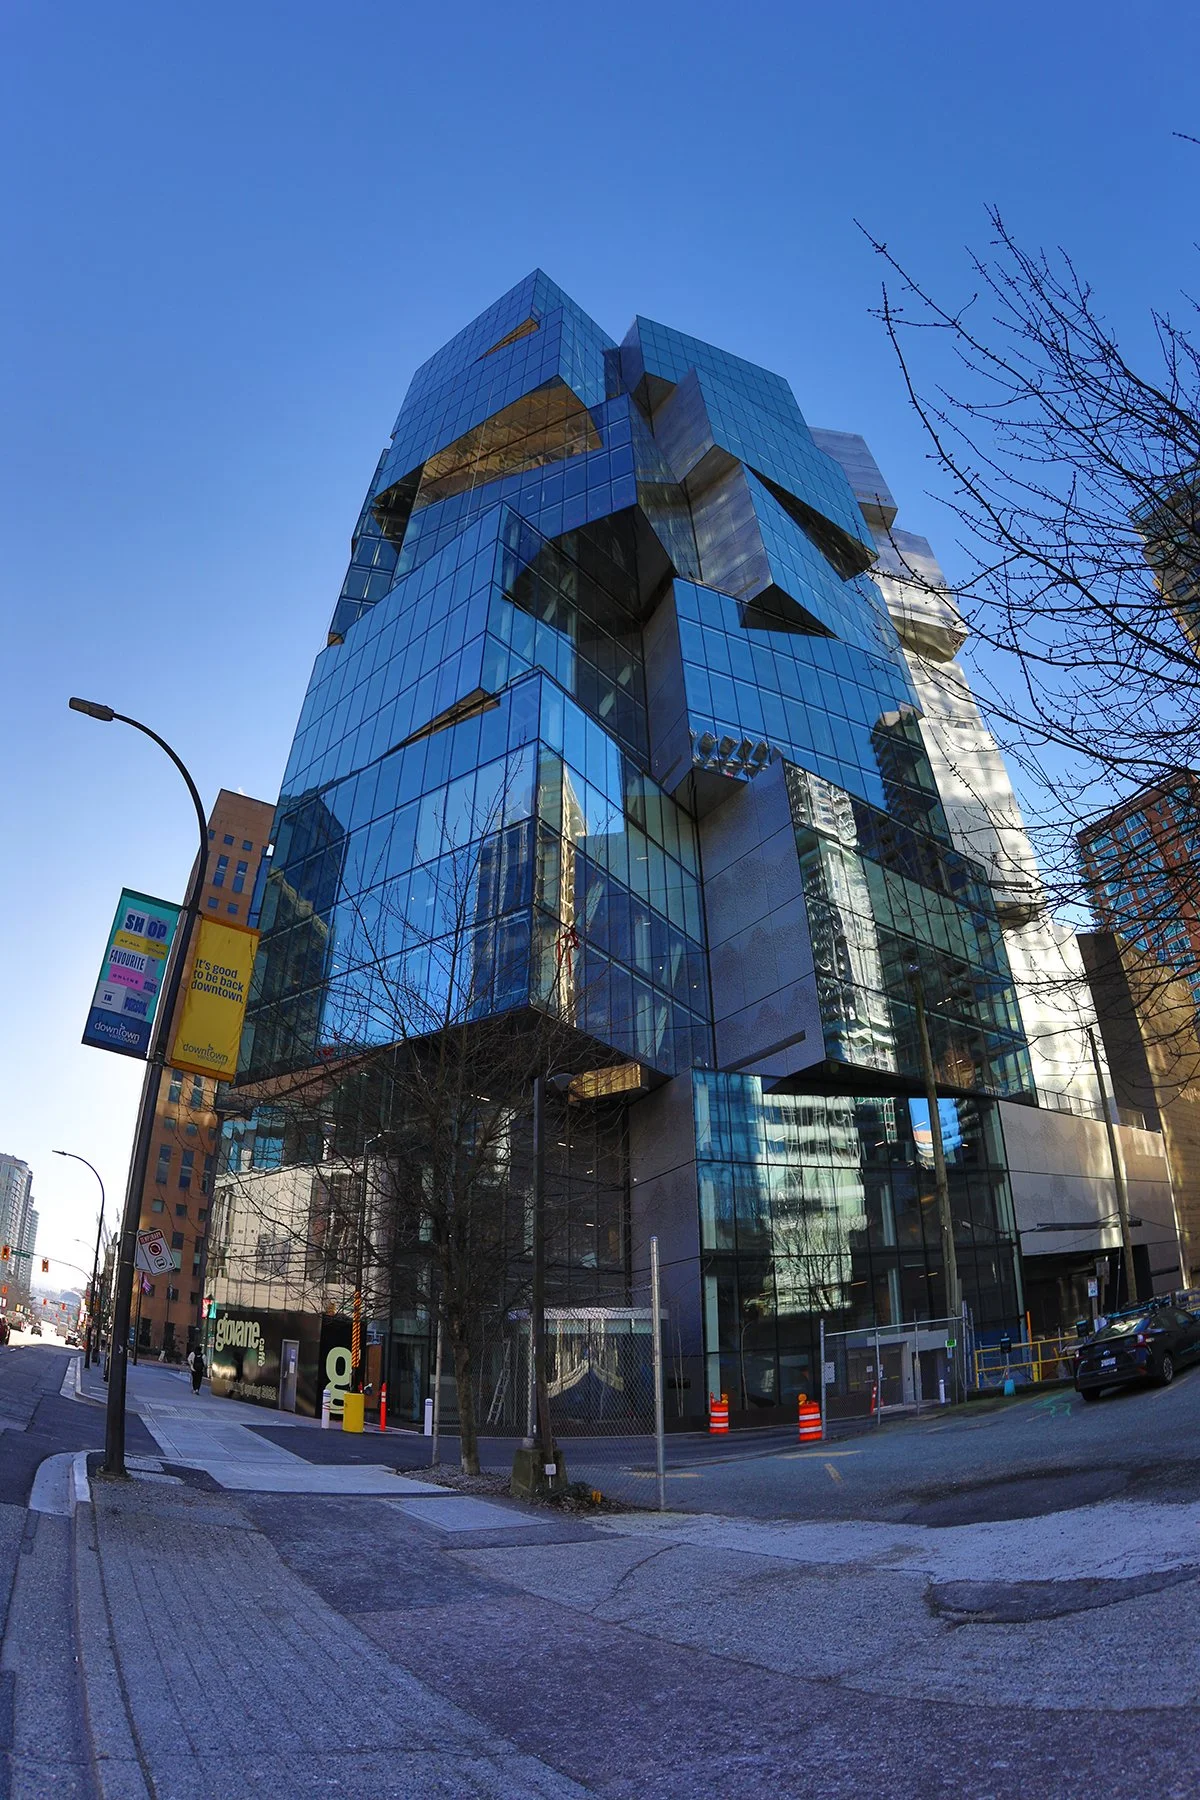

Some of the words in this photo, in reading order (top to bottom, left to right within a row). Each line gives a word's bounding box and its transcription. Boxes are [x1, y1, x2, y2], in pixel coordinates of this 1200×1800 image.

[125, 913, 168, 939] SHOP
[109, 949, 146, 972] FAVOURITE
[195, 958, 211, 971] It's
[212, 964, 238, 979] good
[193, 969, 204, 980] to
[205, 971, 219, 984] be
[219, 976, 245, 992] back
[190, 980, 244, 1005] downtown.
[94, 1021, 140, 1042] downtown
[182, 1043, 229, 1063] downtown
[215, 1312, 261, 1352] giovane
